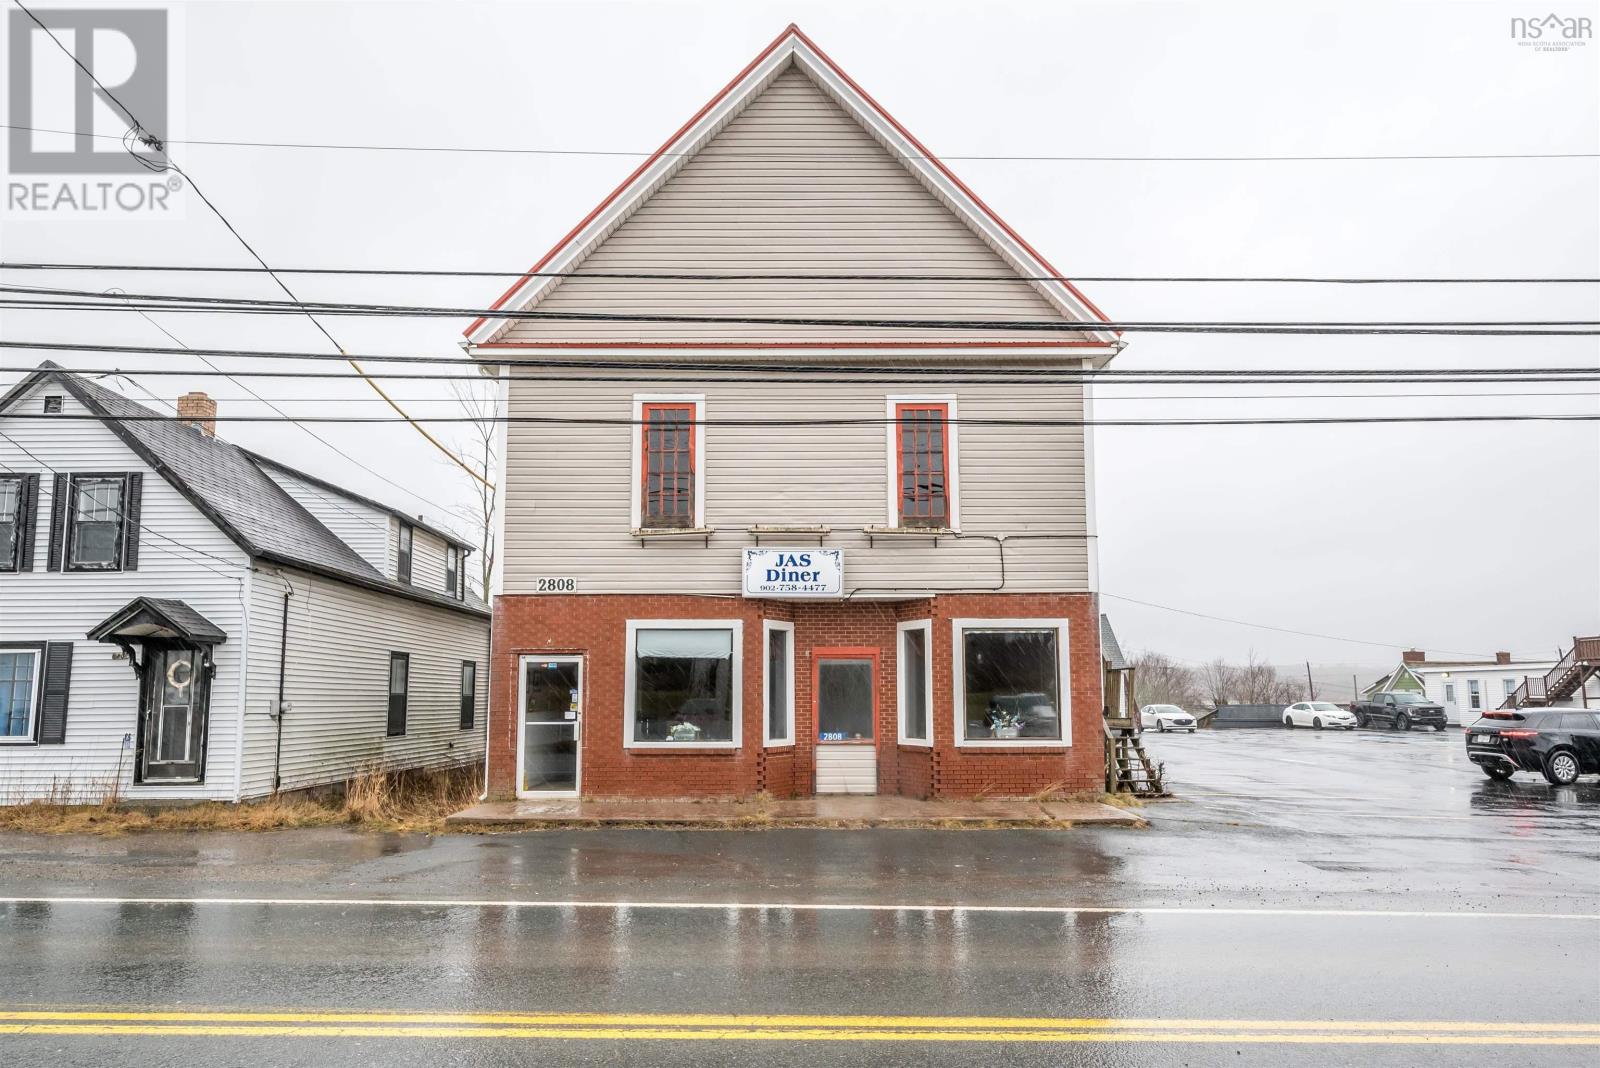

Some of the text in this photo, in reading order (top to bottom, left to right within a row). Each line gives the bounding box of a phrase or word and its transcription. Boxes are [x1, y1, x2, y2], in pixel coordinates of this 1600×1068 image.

[775, 553, 812, 567] JAS
[766, 568, 820, 582] Diner
[538, 578, 575, 591] 2808
[823, 732, 842, 741] 2808
